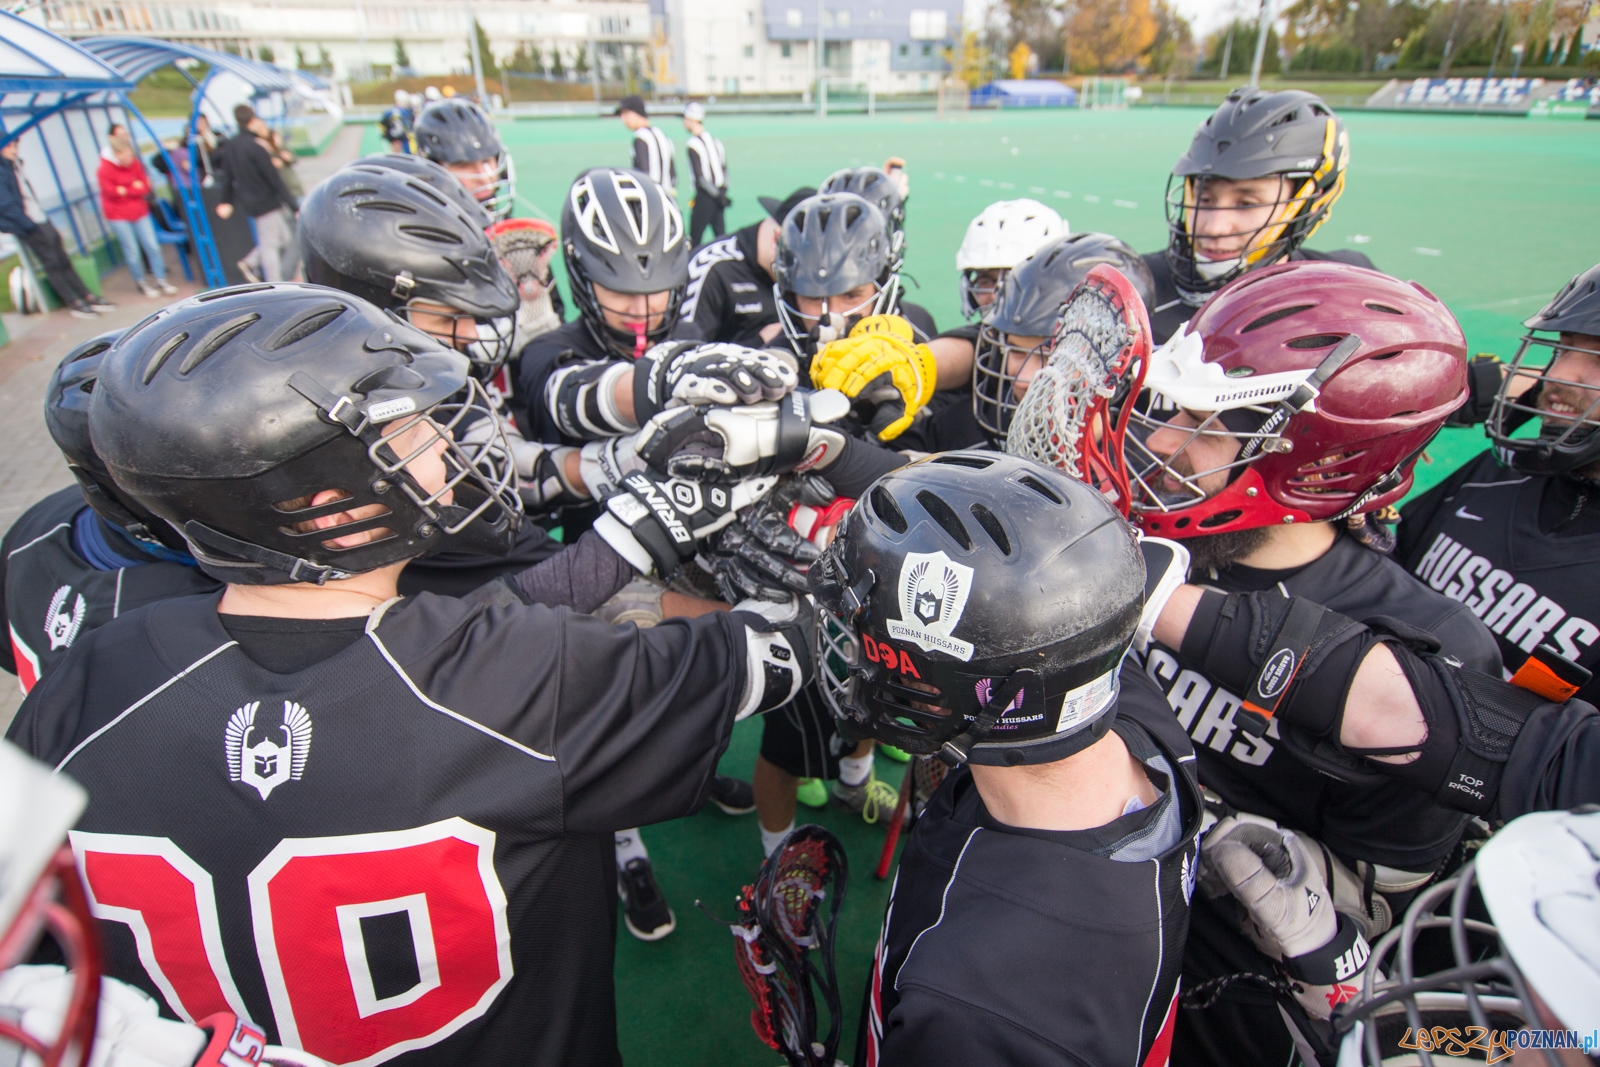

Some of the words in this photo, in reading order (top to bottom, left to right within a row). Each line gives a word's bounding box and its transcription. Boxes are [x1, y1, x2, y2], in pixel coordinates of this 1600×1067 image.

[1215, 383, 1293, 402] WARRIOR
[1240, 409, 1284, 459] WARRIOR
[625, 474, 691, 543] BRINE
[1415, 532, 1600, 662] HUSSARS
[923, 633, 966, 655] HUSSARS
[992, 723, 1018, 731] adies
[1001, 713, 1044, 724] HUSSARS
[1459, 773, 1484, 787] TOP
[1448, 781, 1485, 800] RIGHT
